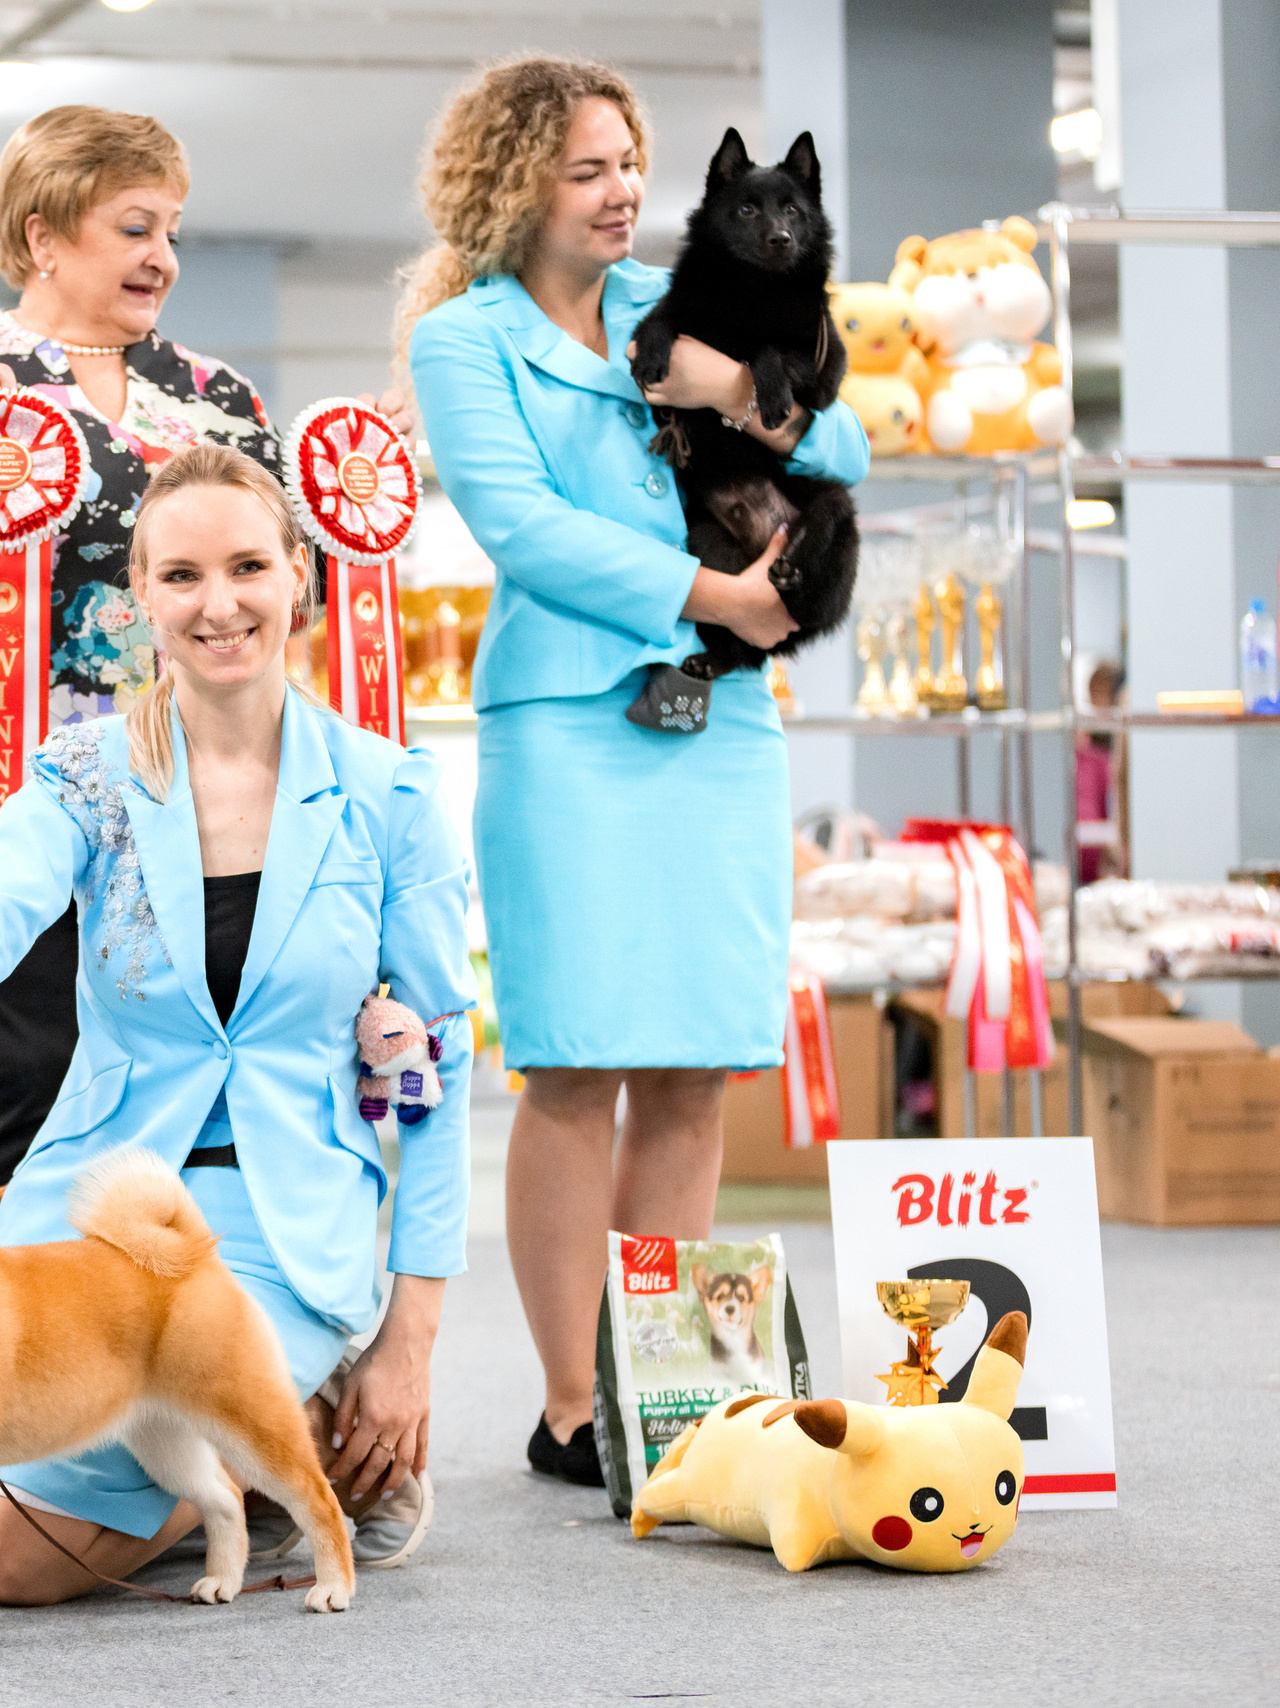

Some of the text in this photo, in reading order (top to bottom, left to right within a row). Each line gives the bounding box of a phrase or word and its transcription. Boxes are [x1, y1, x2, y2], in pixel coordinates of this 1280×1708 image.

[628, 1271, 671, 1291] Blitz
[636, 1387, 716, 1405] TURKEY
[644, 1406, 677, 1417] PUPPY
